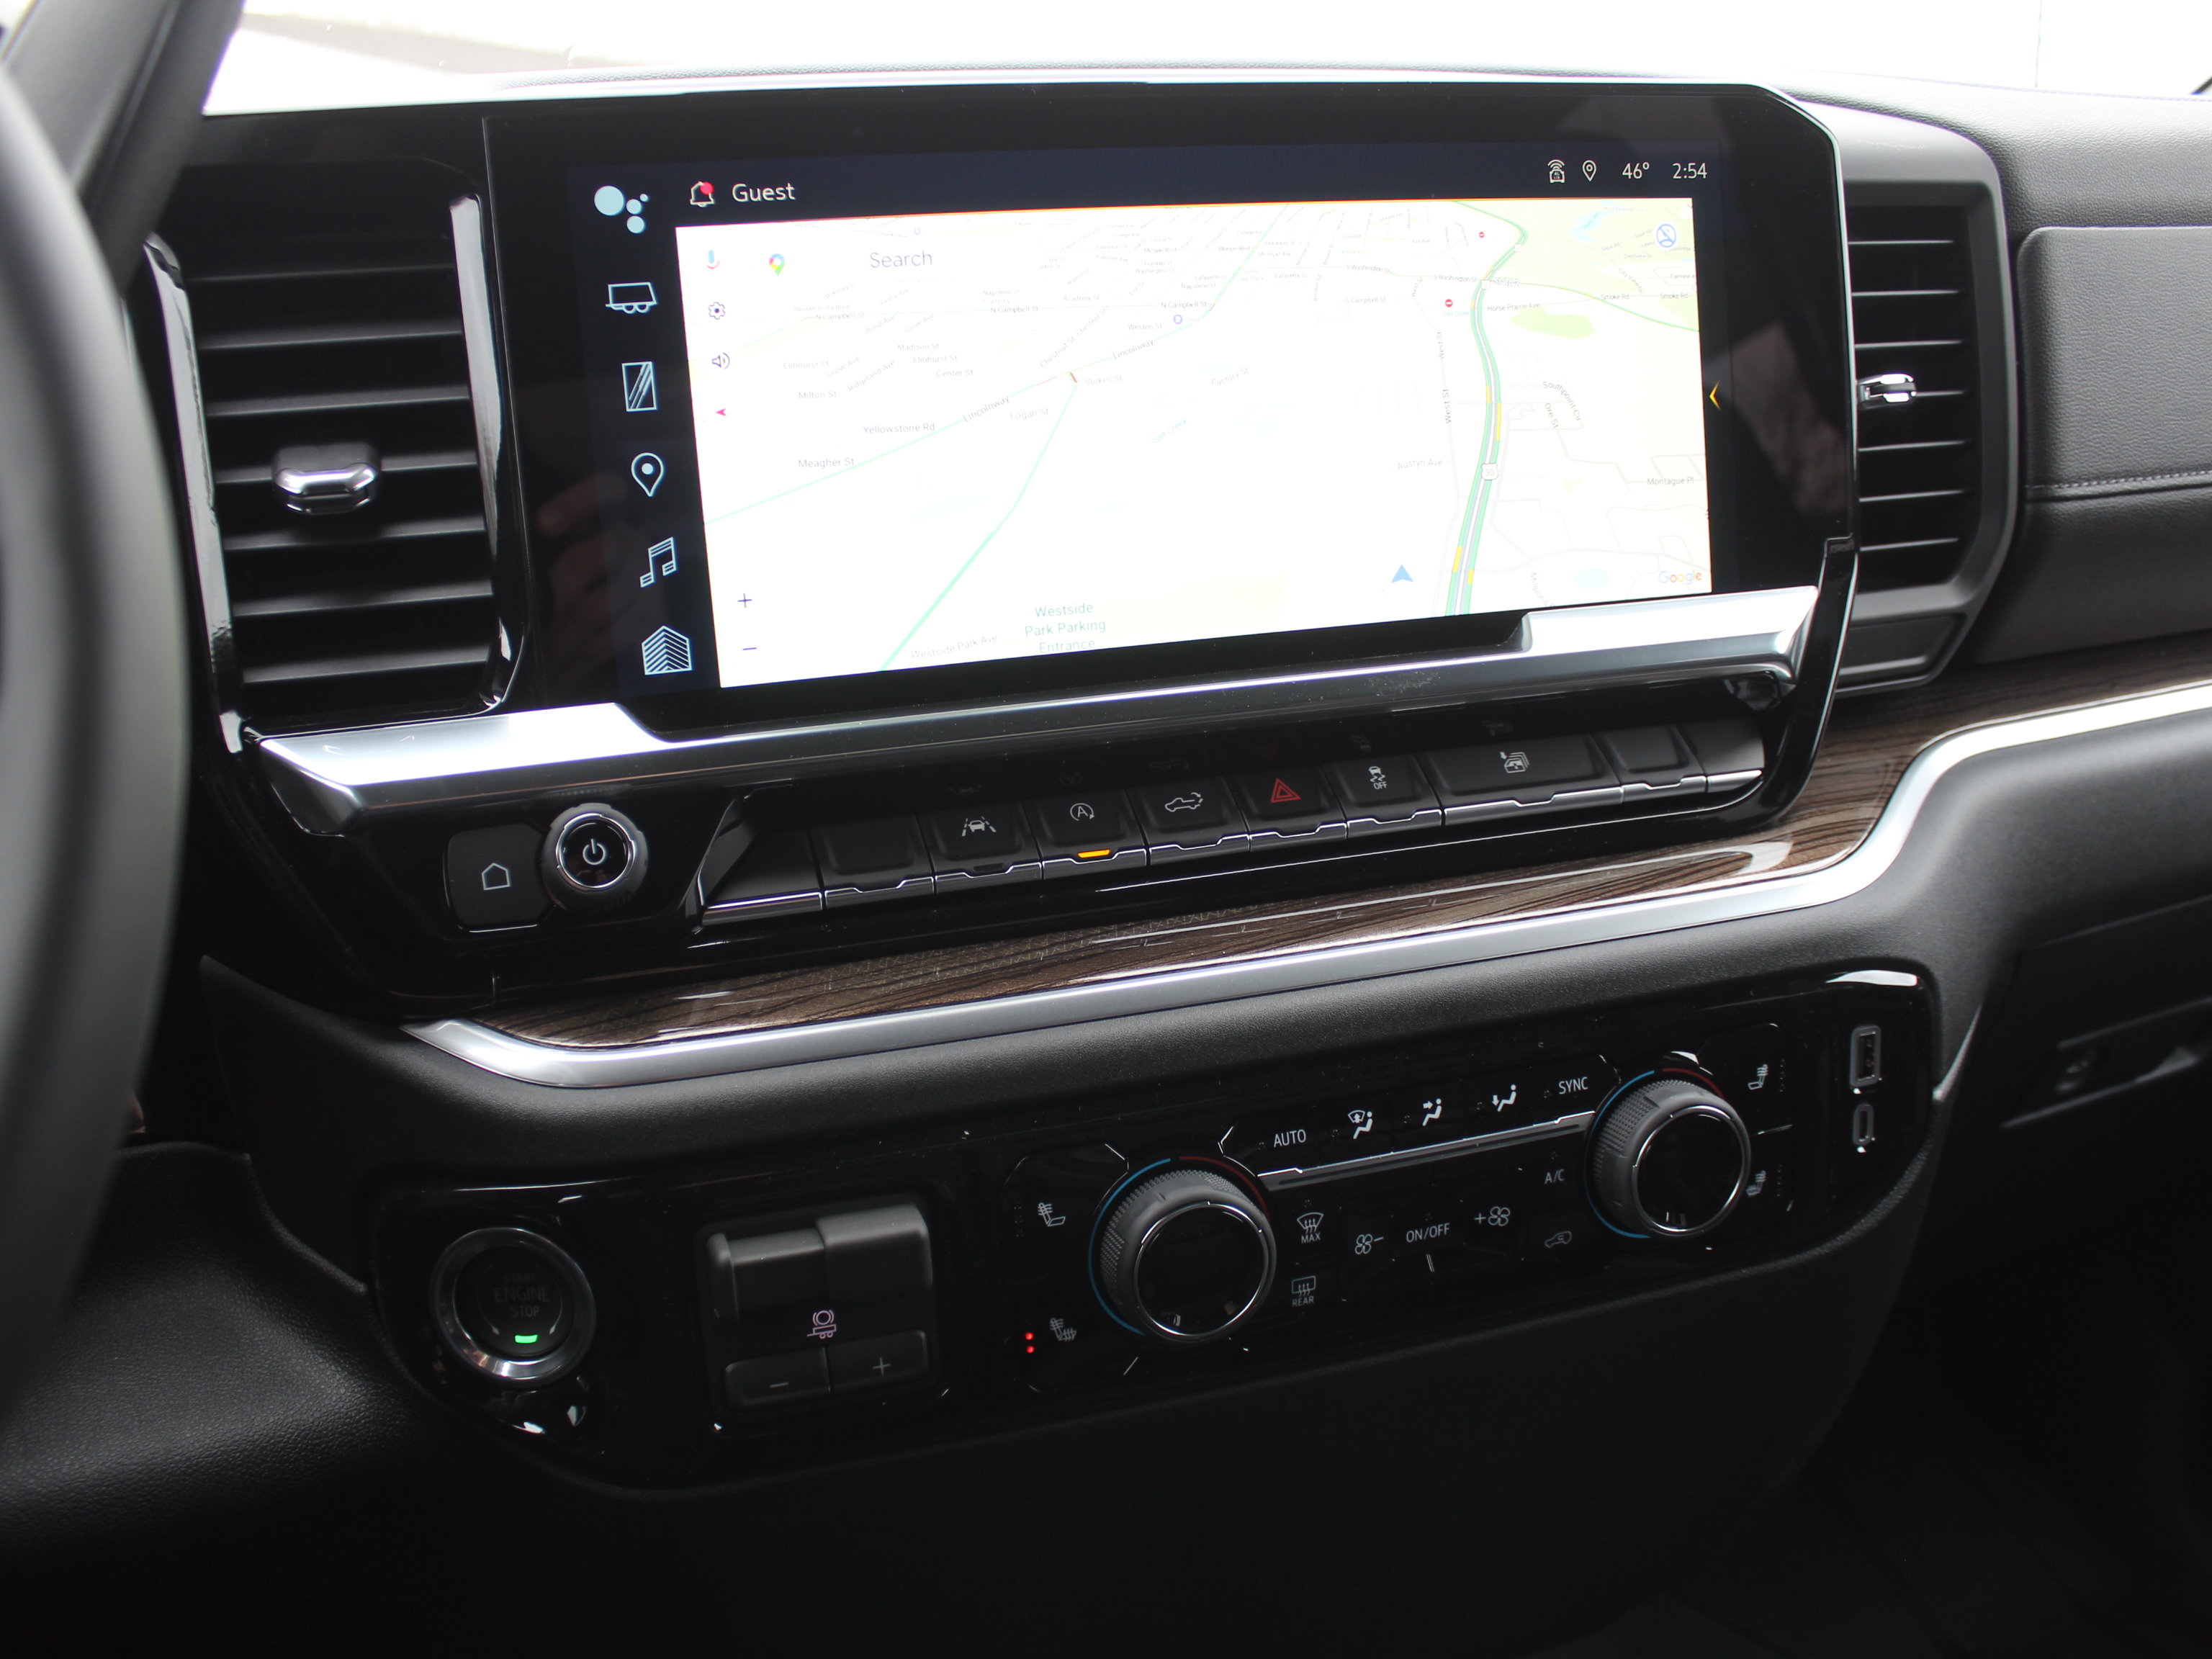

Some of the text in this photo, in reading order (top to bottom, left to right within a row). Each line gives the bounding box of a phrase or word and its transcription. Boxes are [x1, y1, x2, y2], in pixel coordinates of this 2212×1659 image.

[1672, 162, 1707, 179] 2:54
[732, 182, 796, 202] Guest
[869, 251, 933, 269] Search
[1351, 264, 1383, 273] Washington
[1438, 274, 1470, 282] Washington
[1168, 301, 1198, 310] Campbell
[1039, 343, 1066, 368] Chestnut
[1112, 338, 1154, 359] Lincolnway
[1084, 377, 1112, 386] Stokes
[798, 390, 825, 400] Milton
[1542, 381, 1576, 410] Southpoint
[963, 395, 1010, 423] Lincolnway
[1442, 389, 1452, 424] West St
[1545, 403, 1554, 418] Ore
[1010, 410, 1038, 421] Logan
[863, 422, 935, 434] Yellowstone Rd
[798, 457, 855, 469] Meagher St
[1397, 458, 1443, 470] Austyn Ave
[1647, 477, 1685, 487] Montague
[1658, 568, 1702, 585] Google
[1034, 602, 1094, 618] Westside
[1024, 620, 1107, 637] Park Parking
[911, 634, 998, 659] Westside Park Ave
[1038, 639, 1095, 654] Entrance
[1373, 780, 1388, 791] OFF
[1558, 1076, 1589, 1095] SYNC
[1272, 1128, 1307, 1148] AUTO
[1544, 1169, 1565, 1184] A/C
[1300, 1231, 1322, 1244] MAX
[1405, 1222, 1450, 1244] ON/OFF
[494, 1285, 552, 1304] ENGINE
[1291, 1295, 1315, 1308] REAR
[510, 1305, 540, 1318] STOP
